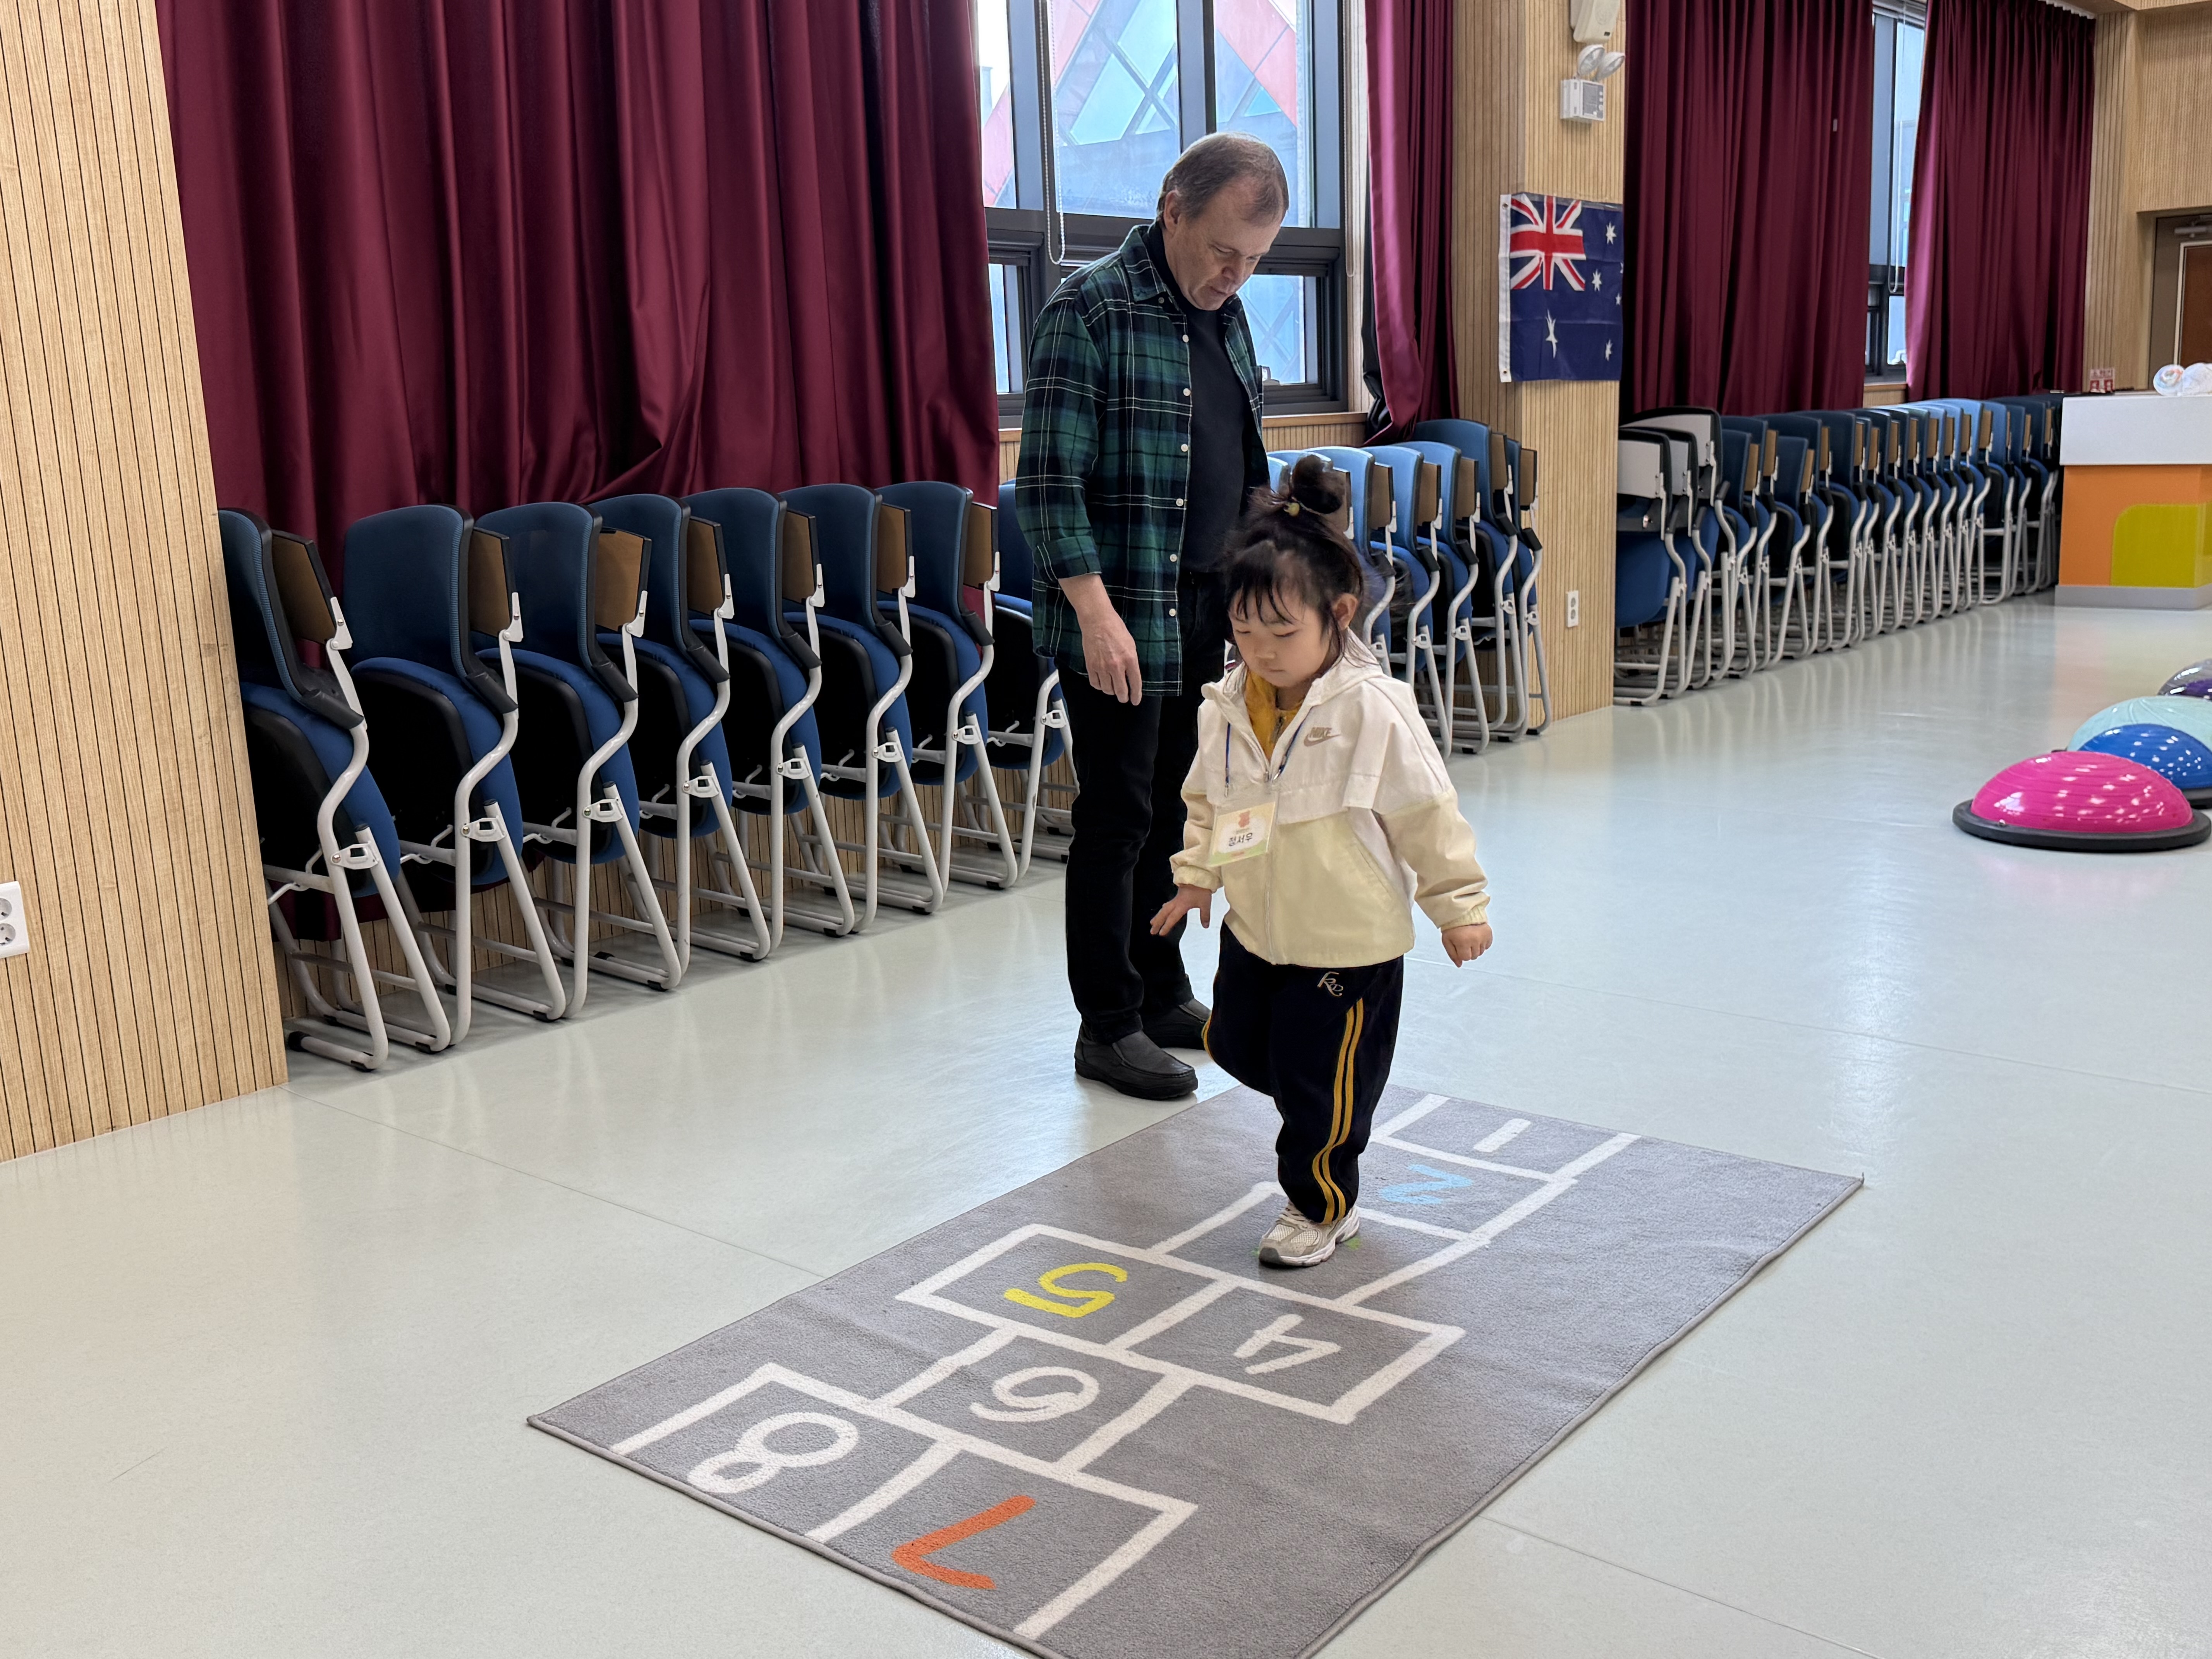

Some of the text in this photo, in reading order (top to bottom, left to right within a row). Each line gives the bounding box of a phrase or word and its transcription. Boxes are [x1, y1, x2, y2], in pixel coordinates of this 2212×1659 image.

[1310, 727, 1333, 738] NIKE
[1379, 1163, 1471, 1204] 2
[1005, 1262, 1128, 1318] 5
[1233, 1314, 1342, 1374] 4
[969, 1367, 1099, 1422] 6
[687, 1412, 859, 1493] 8
[892, 1495, 1036, 1589] 7
